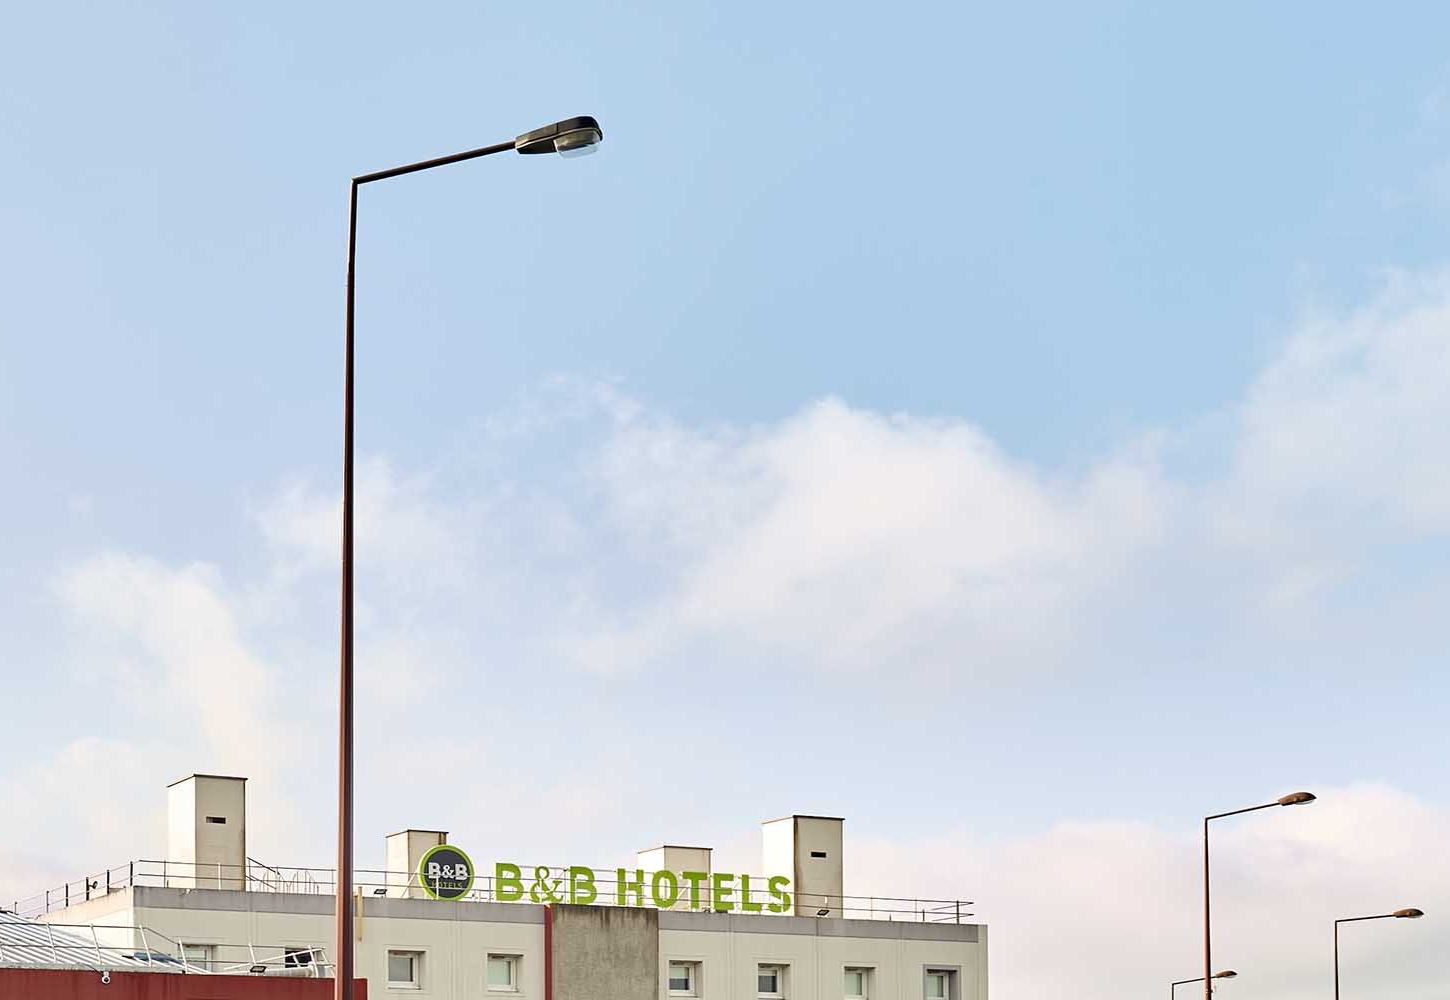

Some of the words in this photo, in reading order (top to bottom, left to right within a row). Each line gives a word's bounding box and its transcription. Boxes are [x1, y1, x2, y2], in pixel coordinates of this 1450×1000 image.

[428, 862, 469, 880] B&B
[496, 862, 597, 905] B&B
[617, 868, 791, 913] HOTELS
